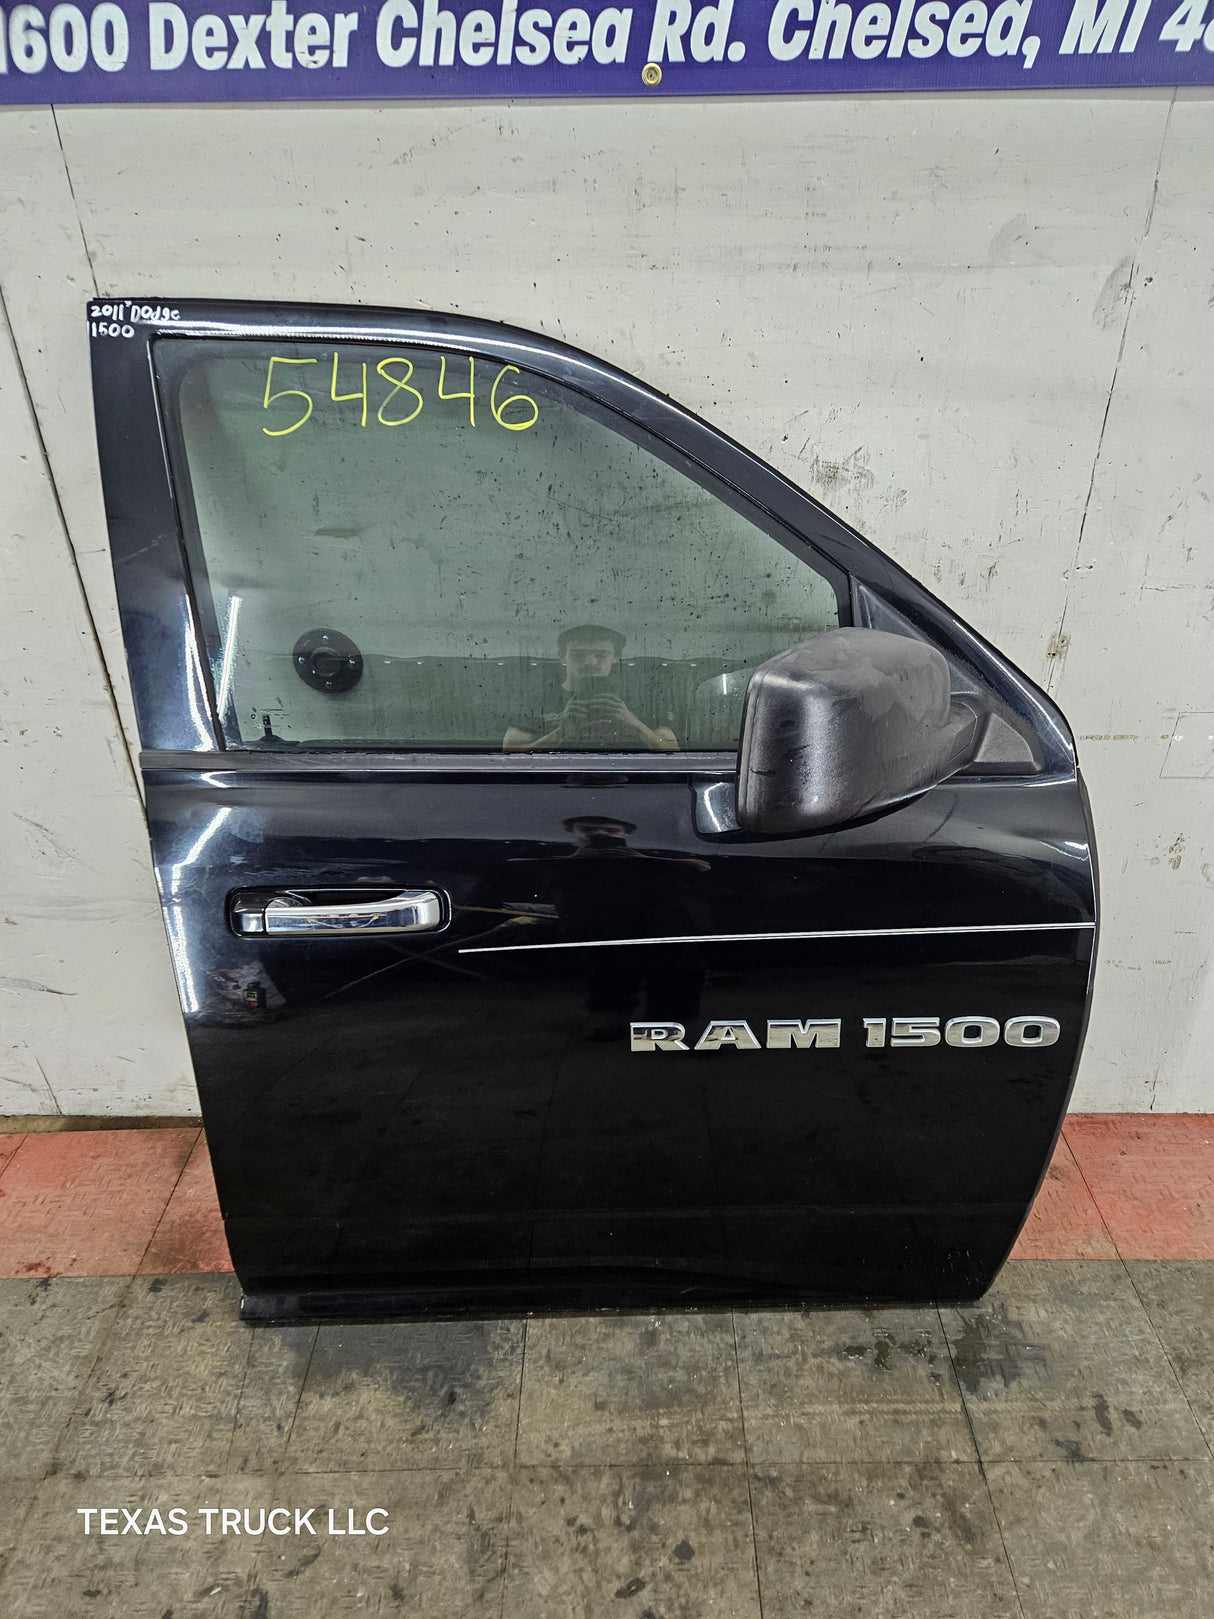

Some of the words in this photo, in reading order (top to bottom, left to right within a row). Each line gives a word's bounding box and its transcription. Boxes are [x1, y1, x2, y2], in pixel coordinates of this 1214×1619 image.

[149, 0, 358, 71] Dexter
[376, 0, 633, 67] Chelsea
[646, 0, 746, 63] Rd.
[768, 0, 1041, 69] Chelsea,
[1058, 0, 1151, 55] MI
[1159, 0, 1214, 53] 4
[91, 321, 135, 338] 1500
[262, 352, 539, 436] 54846
[630, 1018, 842, 1052] RAM
[863, 1015, 1062, 1049] 1500
